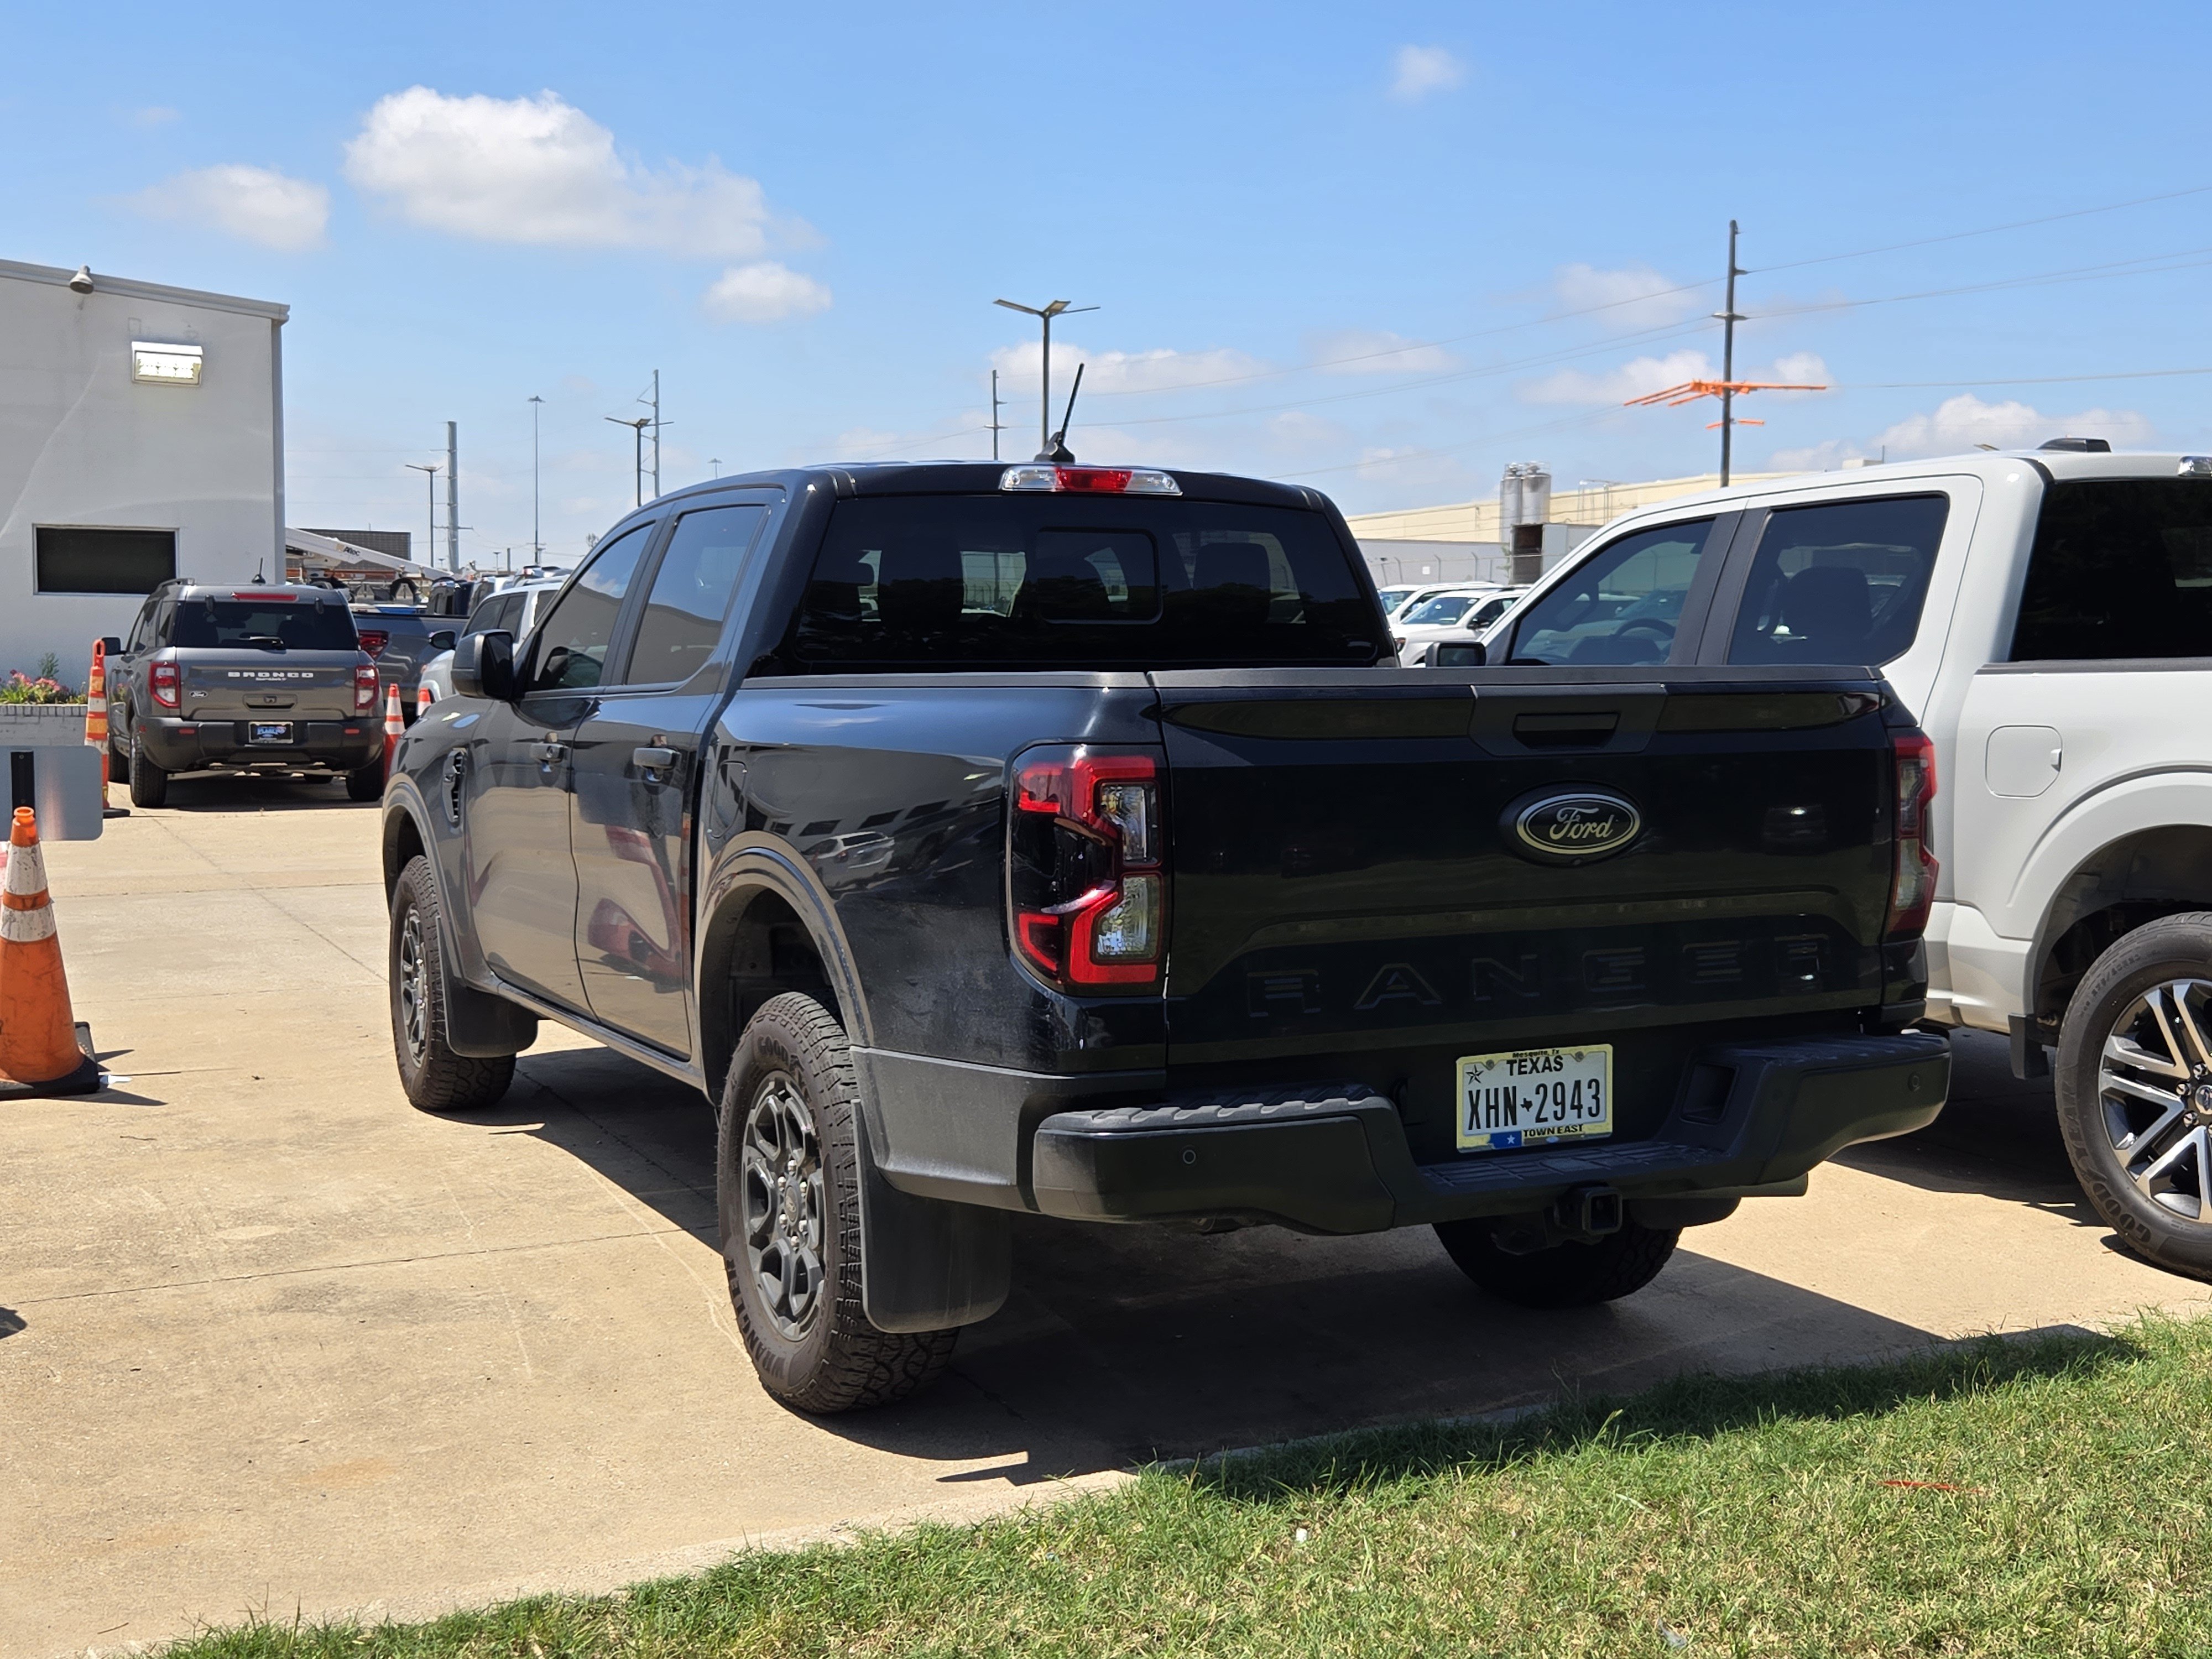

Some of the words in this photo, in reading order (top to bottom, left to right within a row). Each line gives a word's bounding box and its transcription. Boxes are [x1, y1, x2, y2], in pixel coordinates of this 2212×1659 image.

[1550, 807, 1615, 840] Ford
[1245, 933, 1832, 1018] RANGER
[1506, 1055, 1564, 1076] TEXAS
[1523, 1128, 1556, 1137] TOWN
[1556, 1123, 1584, 1134] EAST
